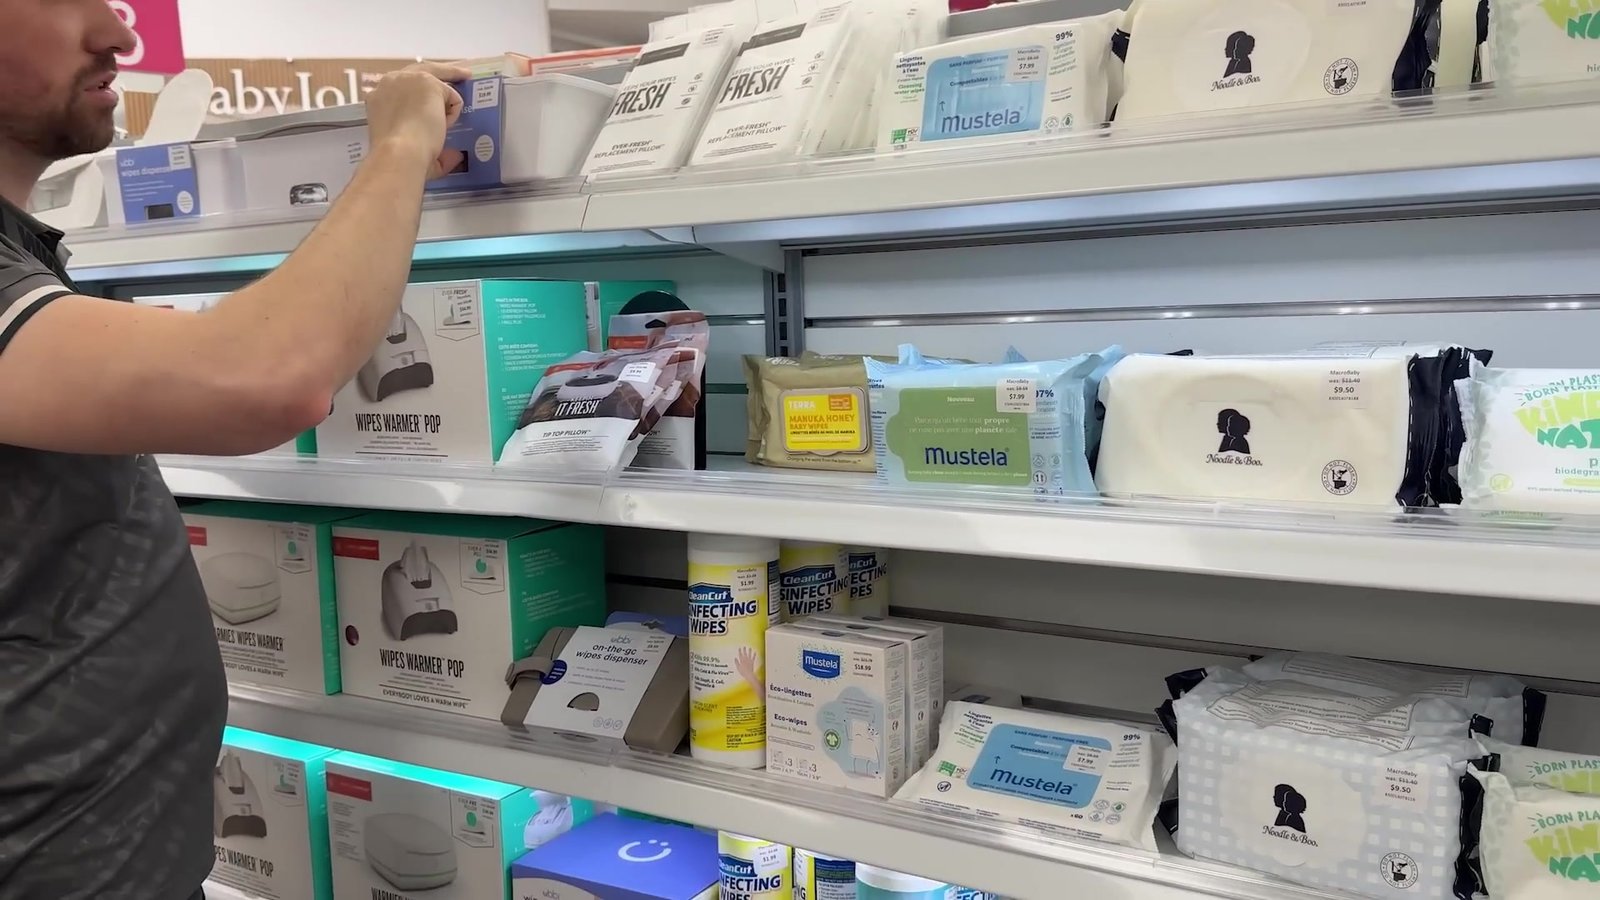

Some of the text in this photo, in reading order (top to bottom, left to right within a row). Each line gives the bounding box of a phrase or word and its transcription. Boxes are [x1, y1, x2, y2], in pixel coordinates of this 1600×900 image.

[1055, 30, 1073, 41] 99%
[719, 64, 791, 104] FRESH
[1210, 78, 1236, 92] Noodle
[608, 82, 673, 119] FRESH
[707, 125, 783, 145] REPLACEMENT PILLOW
[594, 144, 661, 159] REPLACEMENT PILLOW
[1569, 374, 1600, 386] PLAS
[1334, 386, 1355, 394] $9.50
[1524, 386, 1560, 401] BORN
[554, 400, 601, 416] IT FRESH
[789, 400, 816, 410] TERRA
[355, 412, 441, 434] WIPES WARMER POP
[789, 413, 855, 423] MANUKA HONEY
[984, 417, 1010, 425] propre
[564, 429, 588, 437] PILLOW
[789, 422, 829, 431] BABY WIPES
[1206, 453, 1234, 464] Noodle
[1234, 457, 1243, 465] &
[849, 557, 874, 569] nCut
[783, 569, 833, 585] CleanCut
[850, 562, 887, 585] ECTING
[780, 574, 849, 601] SINFECTING
[850, 583, 873, 599] PES
[688, 599, 757, 618] NFECTING
[787, 597, 832, 615] WIPES
[689, 618, 726, 634] WIPES
[216, 627, 284, 652] RMIES WIPES WARMER
[379, 648, 465, 679] WIPES WARMER POP
[576, 650, 649, 665] wipes dispenser
[854, 663, 872, 671] $18.99
[769, 683, 812, 698] Éco-lingettes
[382, 688, 413, 701] EVERYBODY
[413, 693, 430, 703] LOVES
[435, 697, 452, 707] WARM
[452, 701, 468, 709] WIPE
[774, 713, 808, 726] Eco-wipes
[1122, 733, 1141, 741] 99%
[1010, 743, 1050, 755] Compostables
[1386, 767, 1418, 778] MacroBaby
[1534, 760, 1568, 775] BORN
[1390, 784, 1412, 794] $9.50
[1537, 811, 1574, 829] BORN
[1261, 824, 1290, 840] Noodle
[1290, 832, 1299, 842] &
[213, 844, 274, 878] PES WARMER POP
